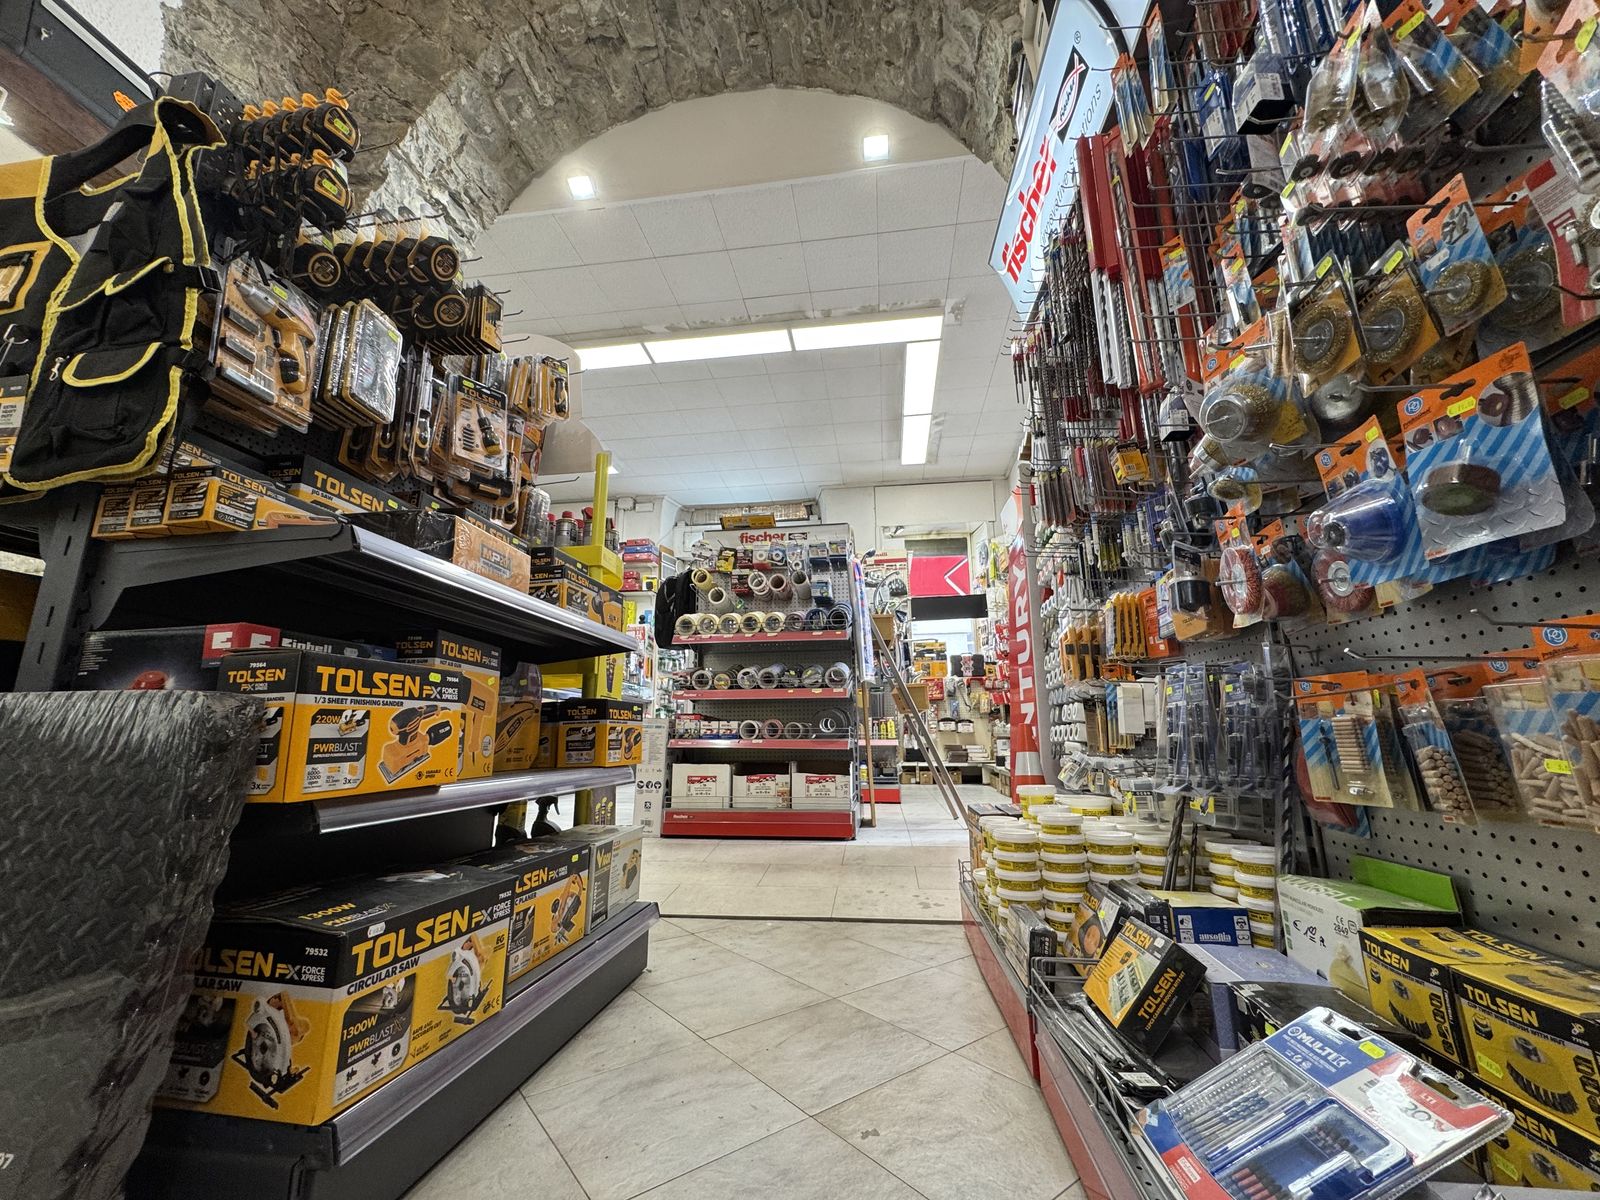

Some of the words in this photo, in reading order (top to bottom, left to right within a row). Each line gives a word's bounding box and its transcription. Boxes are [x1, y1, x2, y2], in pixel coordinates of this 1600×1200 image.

[1002, 135, 1057, 283] fischer
[174, 471, 200, 480] TOLSEN
[221, 469, 268, 495] TOLSEN
[314, 470, 384, 512] TOLSEN
[739, 531, 786, 544] fischer
[441, 640, 482, 662] TOLSEN
[228, 668, 287, 684] TOLSEN
[316, 665, 421, 698] TOLSEN
[314, 697, 326, 705] 1/3
[327, 697, 349, 705] SHEET
[350, 698, 381, 706] FINISHING
[382, 699, 404, 708] SANDER
[567, 708, 597, 716] TOLSEN
[609, 709, 632, 719] TOLSEN
[316, 715, 341, 725] 220W
[313, 742, 359, 753] PWRBLAST
[515, 867, 548, 893] LSEN
[492, 908, 511, 920] XPRESS
[493, 900, 512, 912] FORCE
[352, 905, 470, 976] TOLSEN
[1124, 922, 1153, 949] TOLSEN
[1463, 929, 1547, 960] TOLSEN
[192, 947, 274, 978] OLSEN
[305, 947, 328, 957] 79532
[1364, 939, 1410, 972] TOLSEN
[301, 965, 326, 975] FORCE
[301, 973, 325, 983] XPRESS
[347, 966, 400, 995] CIRCULAR
[399, 956, 420, 973] SAW
[1138, 967, 1178, 1020] TOLSEN
[1462, 983, 1539, 1027] TOLSEN
[342, 1014, 379, 1041] 1300W
